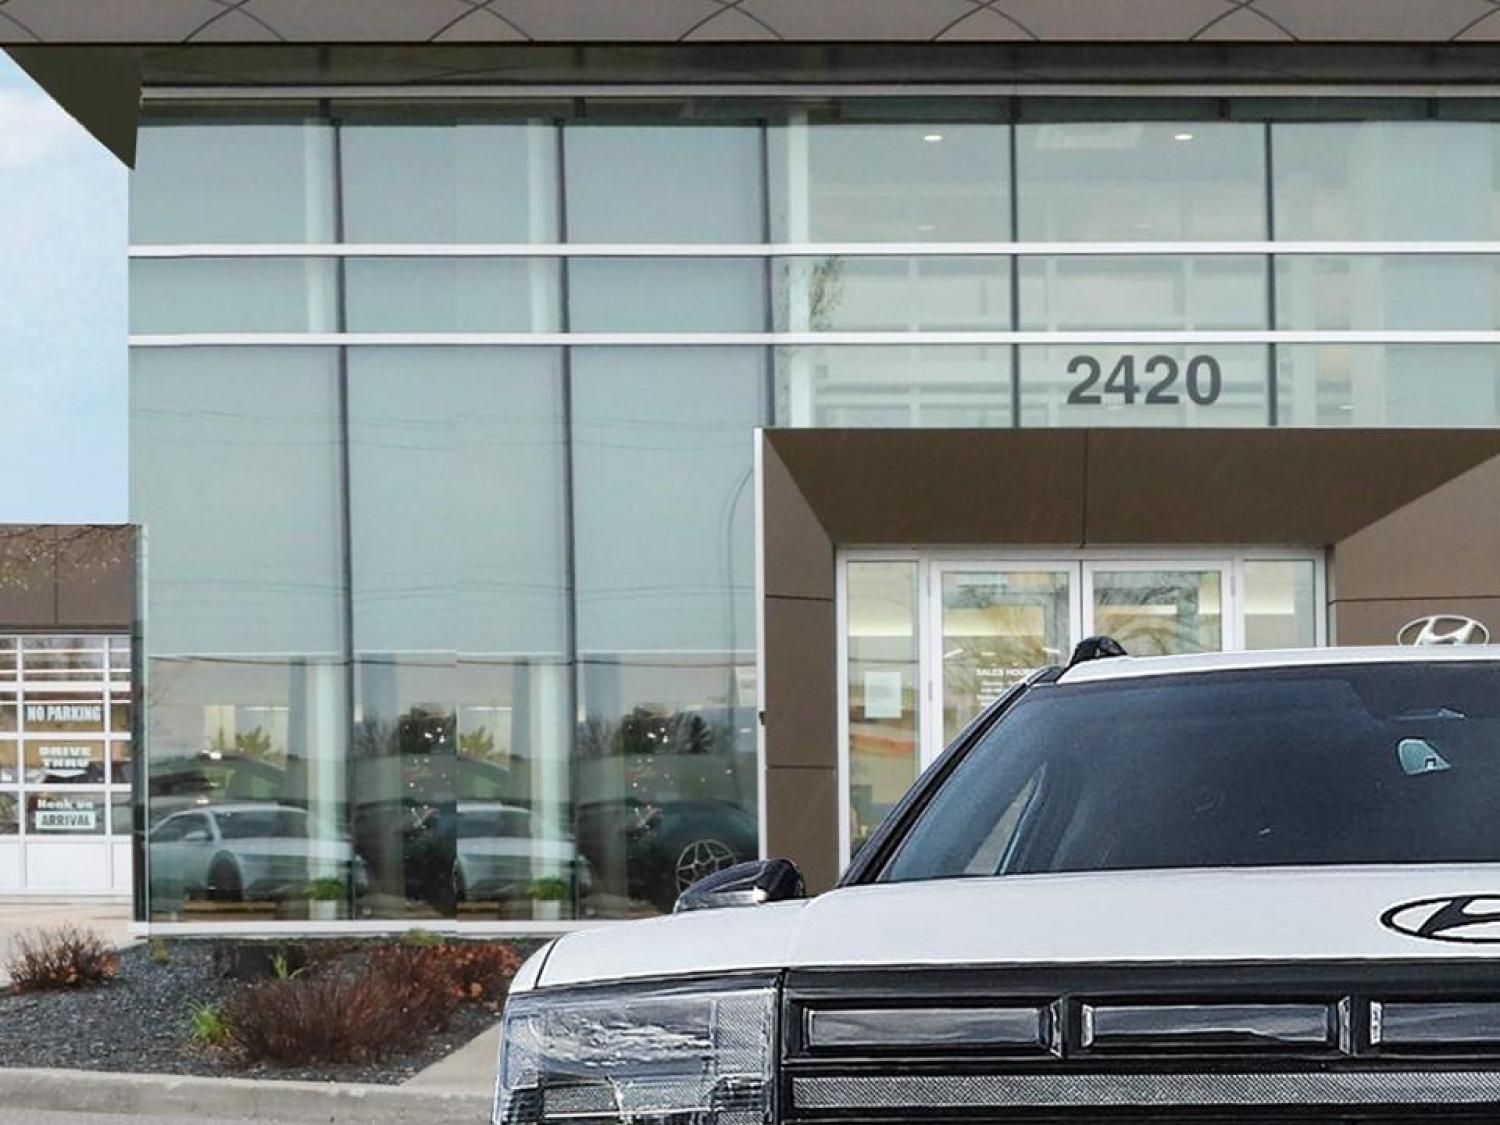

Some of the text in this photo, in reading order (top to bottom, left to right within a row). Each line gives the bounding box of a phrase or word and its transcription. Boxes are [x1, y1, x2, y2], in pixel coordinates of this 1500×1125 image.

[1066, 355, 1222, 405] 2420
[27, 705, 101, 721] NO PARKING
[39, 746, 91, 757] DRIVE
[42, 758, 89, 768] THRU
[41, 814, 91, 826] ARRIVAL
